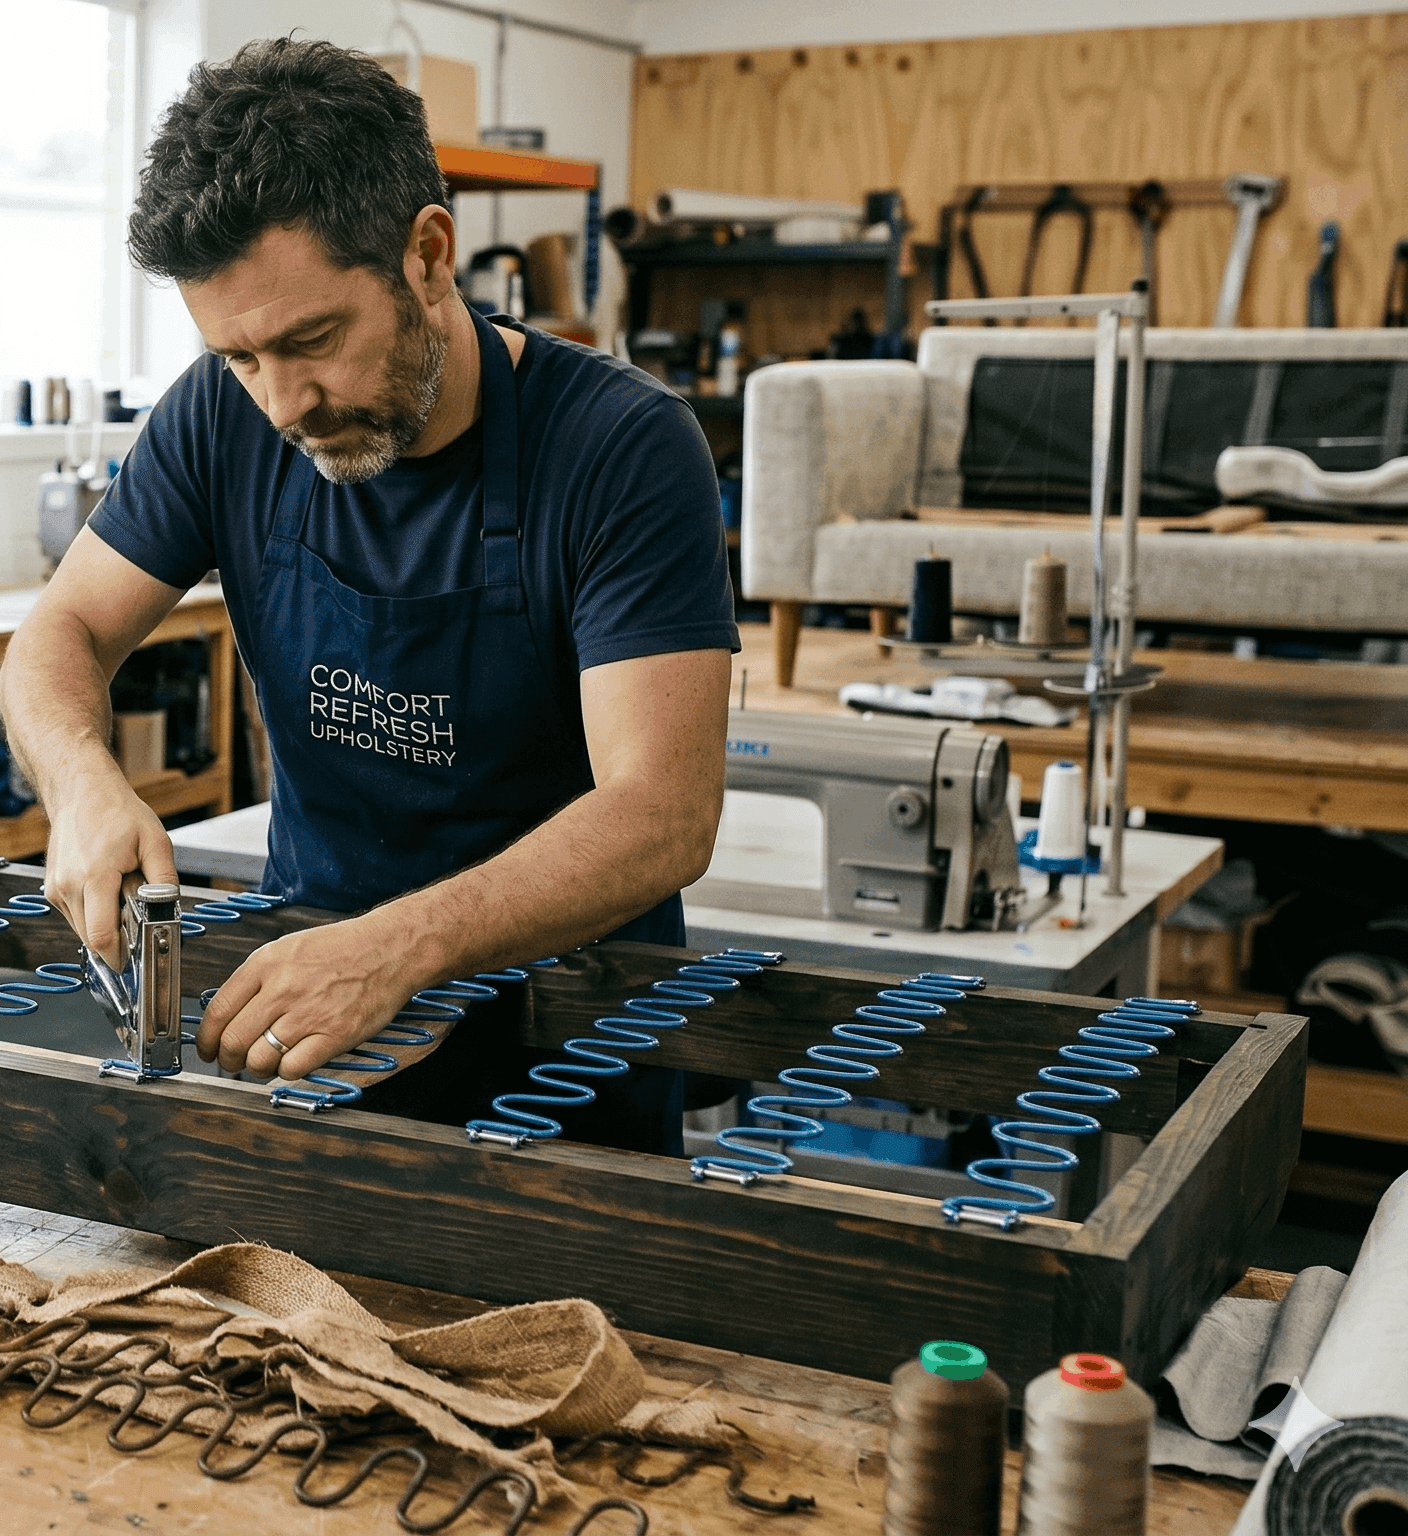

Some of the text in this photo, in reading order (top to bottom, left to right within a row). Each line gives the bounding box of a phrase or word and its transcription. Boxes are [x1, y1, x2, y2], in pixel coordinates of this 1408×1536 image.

[310, 664, 451, 716] COMFORT
[310, 691, 454, 746] REFRESH
[310, 720, 457, 767] UPHOLSTERY
[727, 741, 769, 756] UKI
